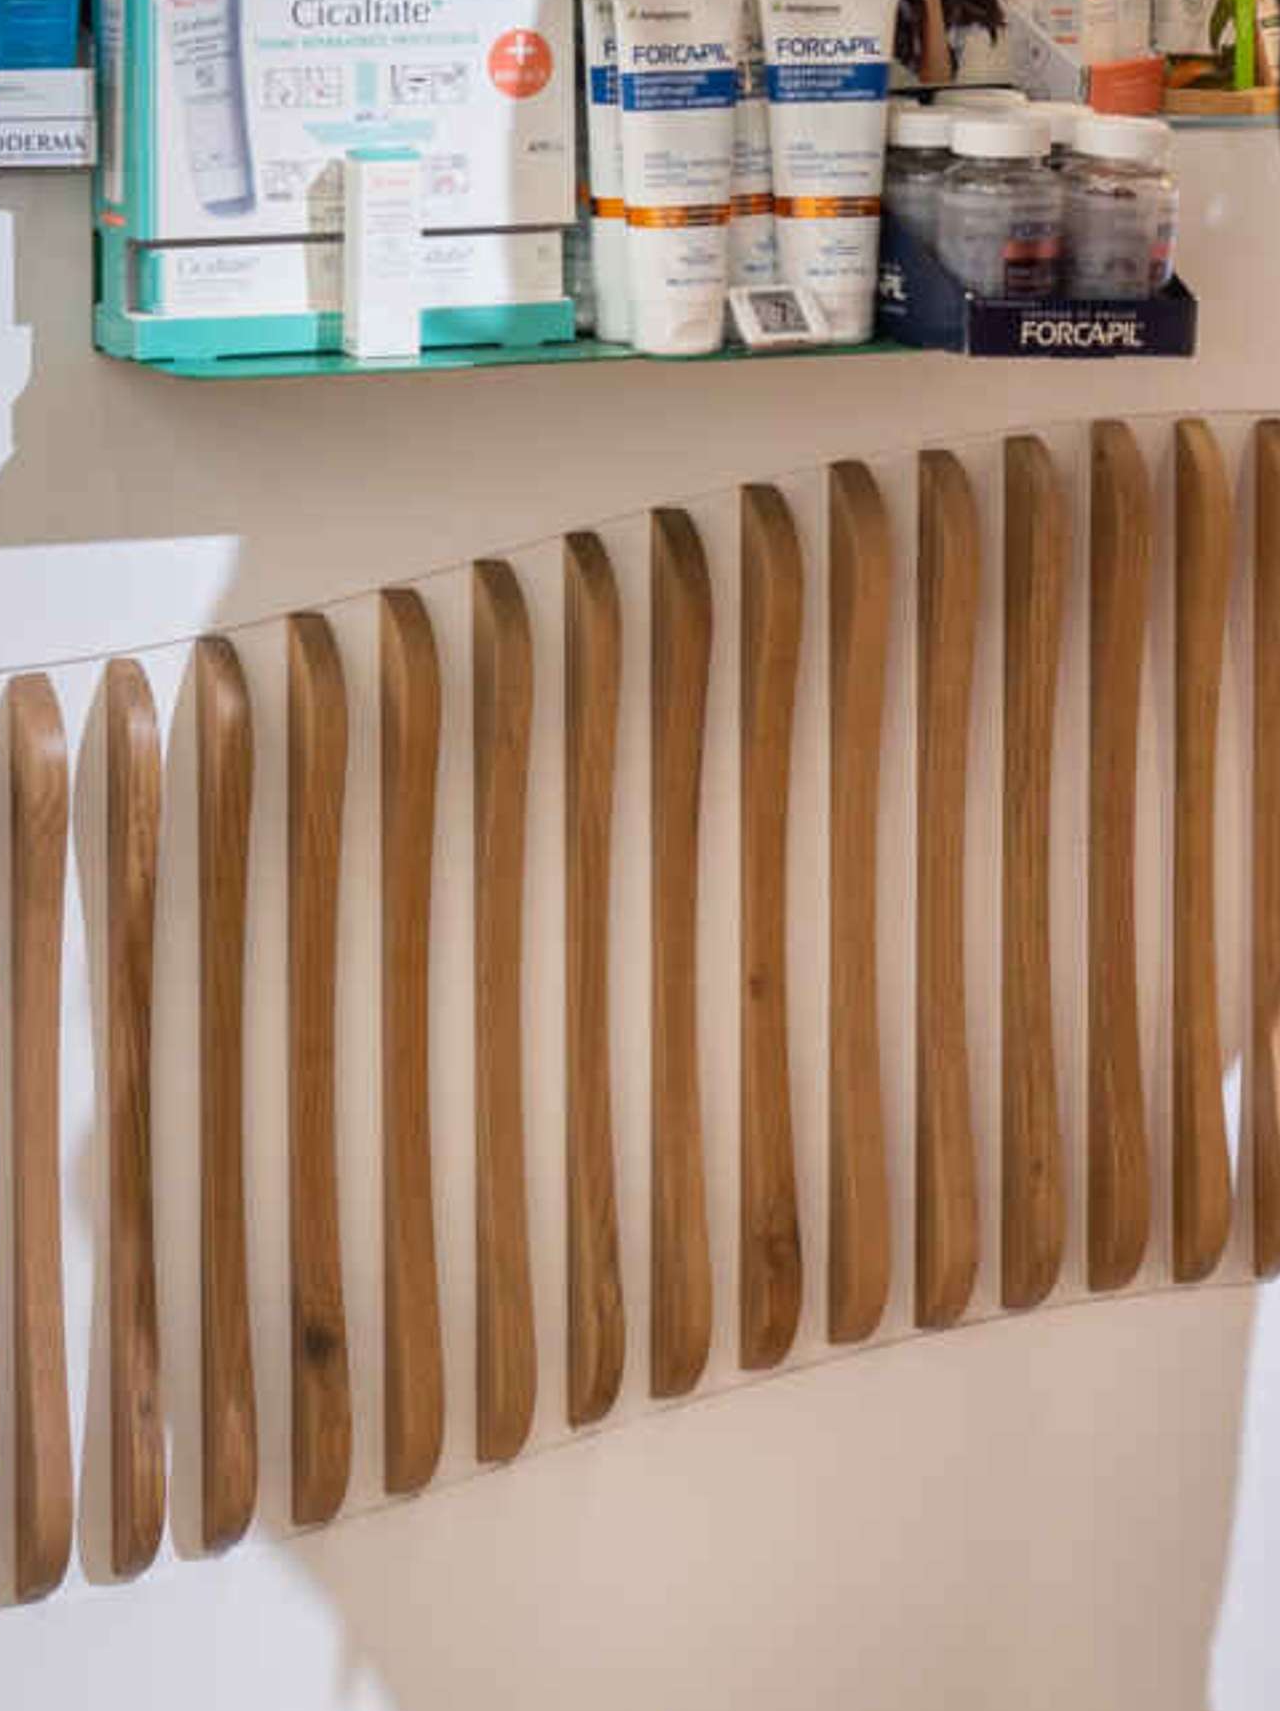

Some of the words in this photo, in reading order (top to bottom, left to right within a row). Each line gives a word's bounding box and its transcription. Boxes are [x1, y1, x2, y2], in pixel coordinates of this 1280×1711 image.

[632, 42, 732, 66] FORCAPIL
[776, 36, 881, 57] FORCAPIL
[1020, 320, 1142, 346] FORCAPIL
